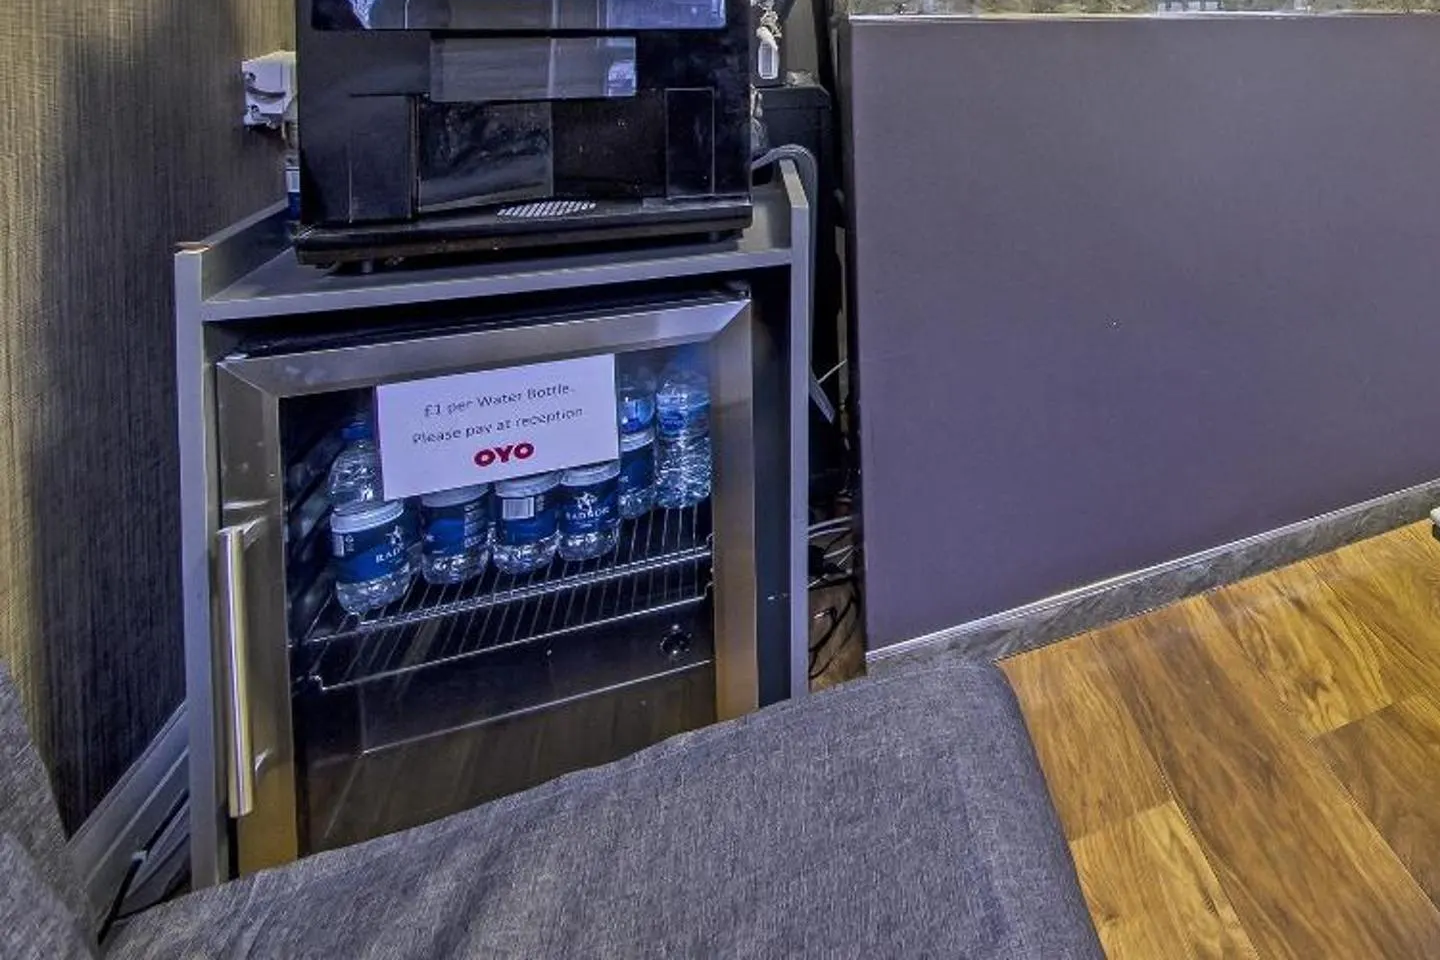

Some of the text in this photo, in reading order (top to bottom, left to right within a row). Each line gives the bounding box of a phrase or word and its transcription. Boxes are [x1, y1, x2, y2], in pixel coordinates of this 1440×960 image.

[424, 403, 441, 417] £1
[447, 399, 472, 414] per
[476, 392, 523, 408] Water
[412, 407, 583, 445] Please pay at reception
[473, 442, 535, 467] OYO
